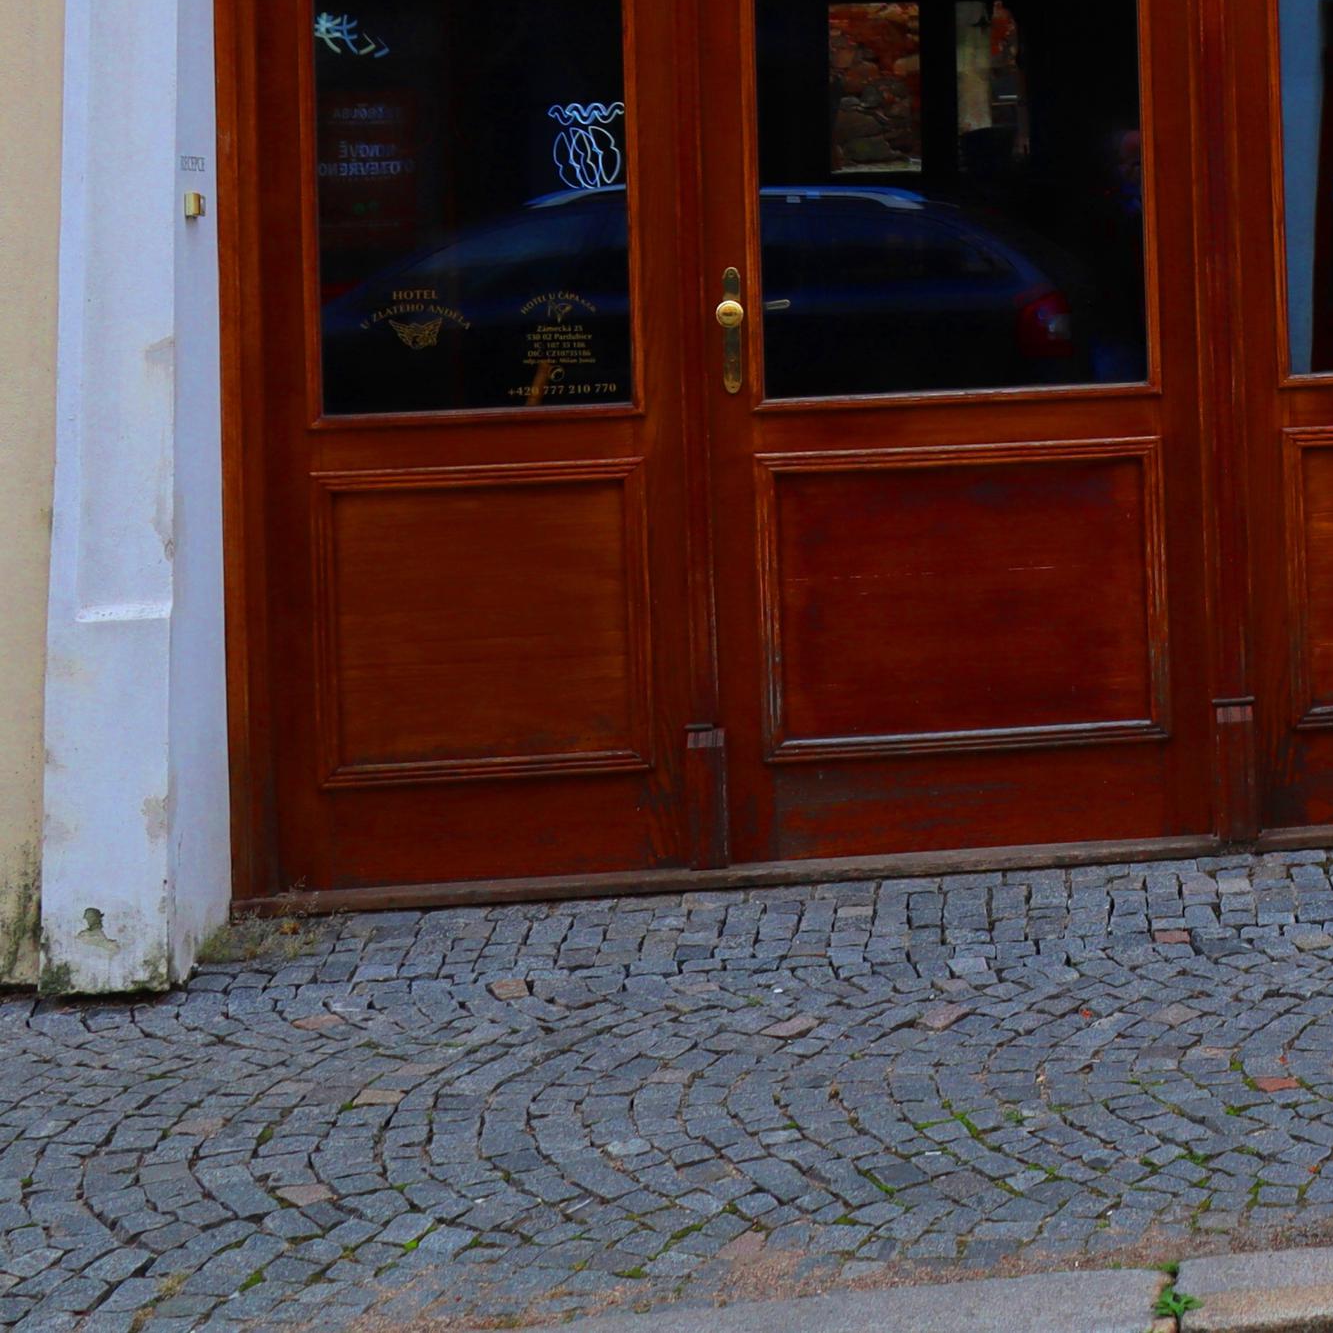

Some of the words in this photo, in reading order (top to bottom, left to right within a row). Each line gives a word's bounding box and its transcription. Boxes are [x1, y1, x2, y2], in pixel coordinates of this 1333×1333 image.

[392, 290, 439, 300] HOTEL
[520, 294, 547, 315] HOTEL
[507, 385, 540, 396] +420
[543, 384, 565, 395] 777
[568, 383, 591, 395] 210
[594, 382, 617, 394] 770
